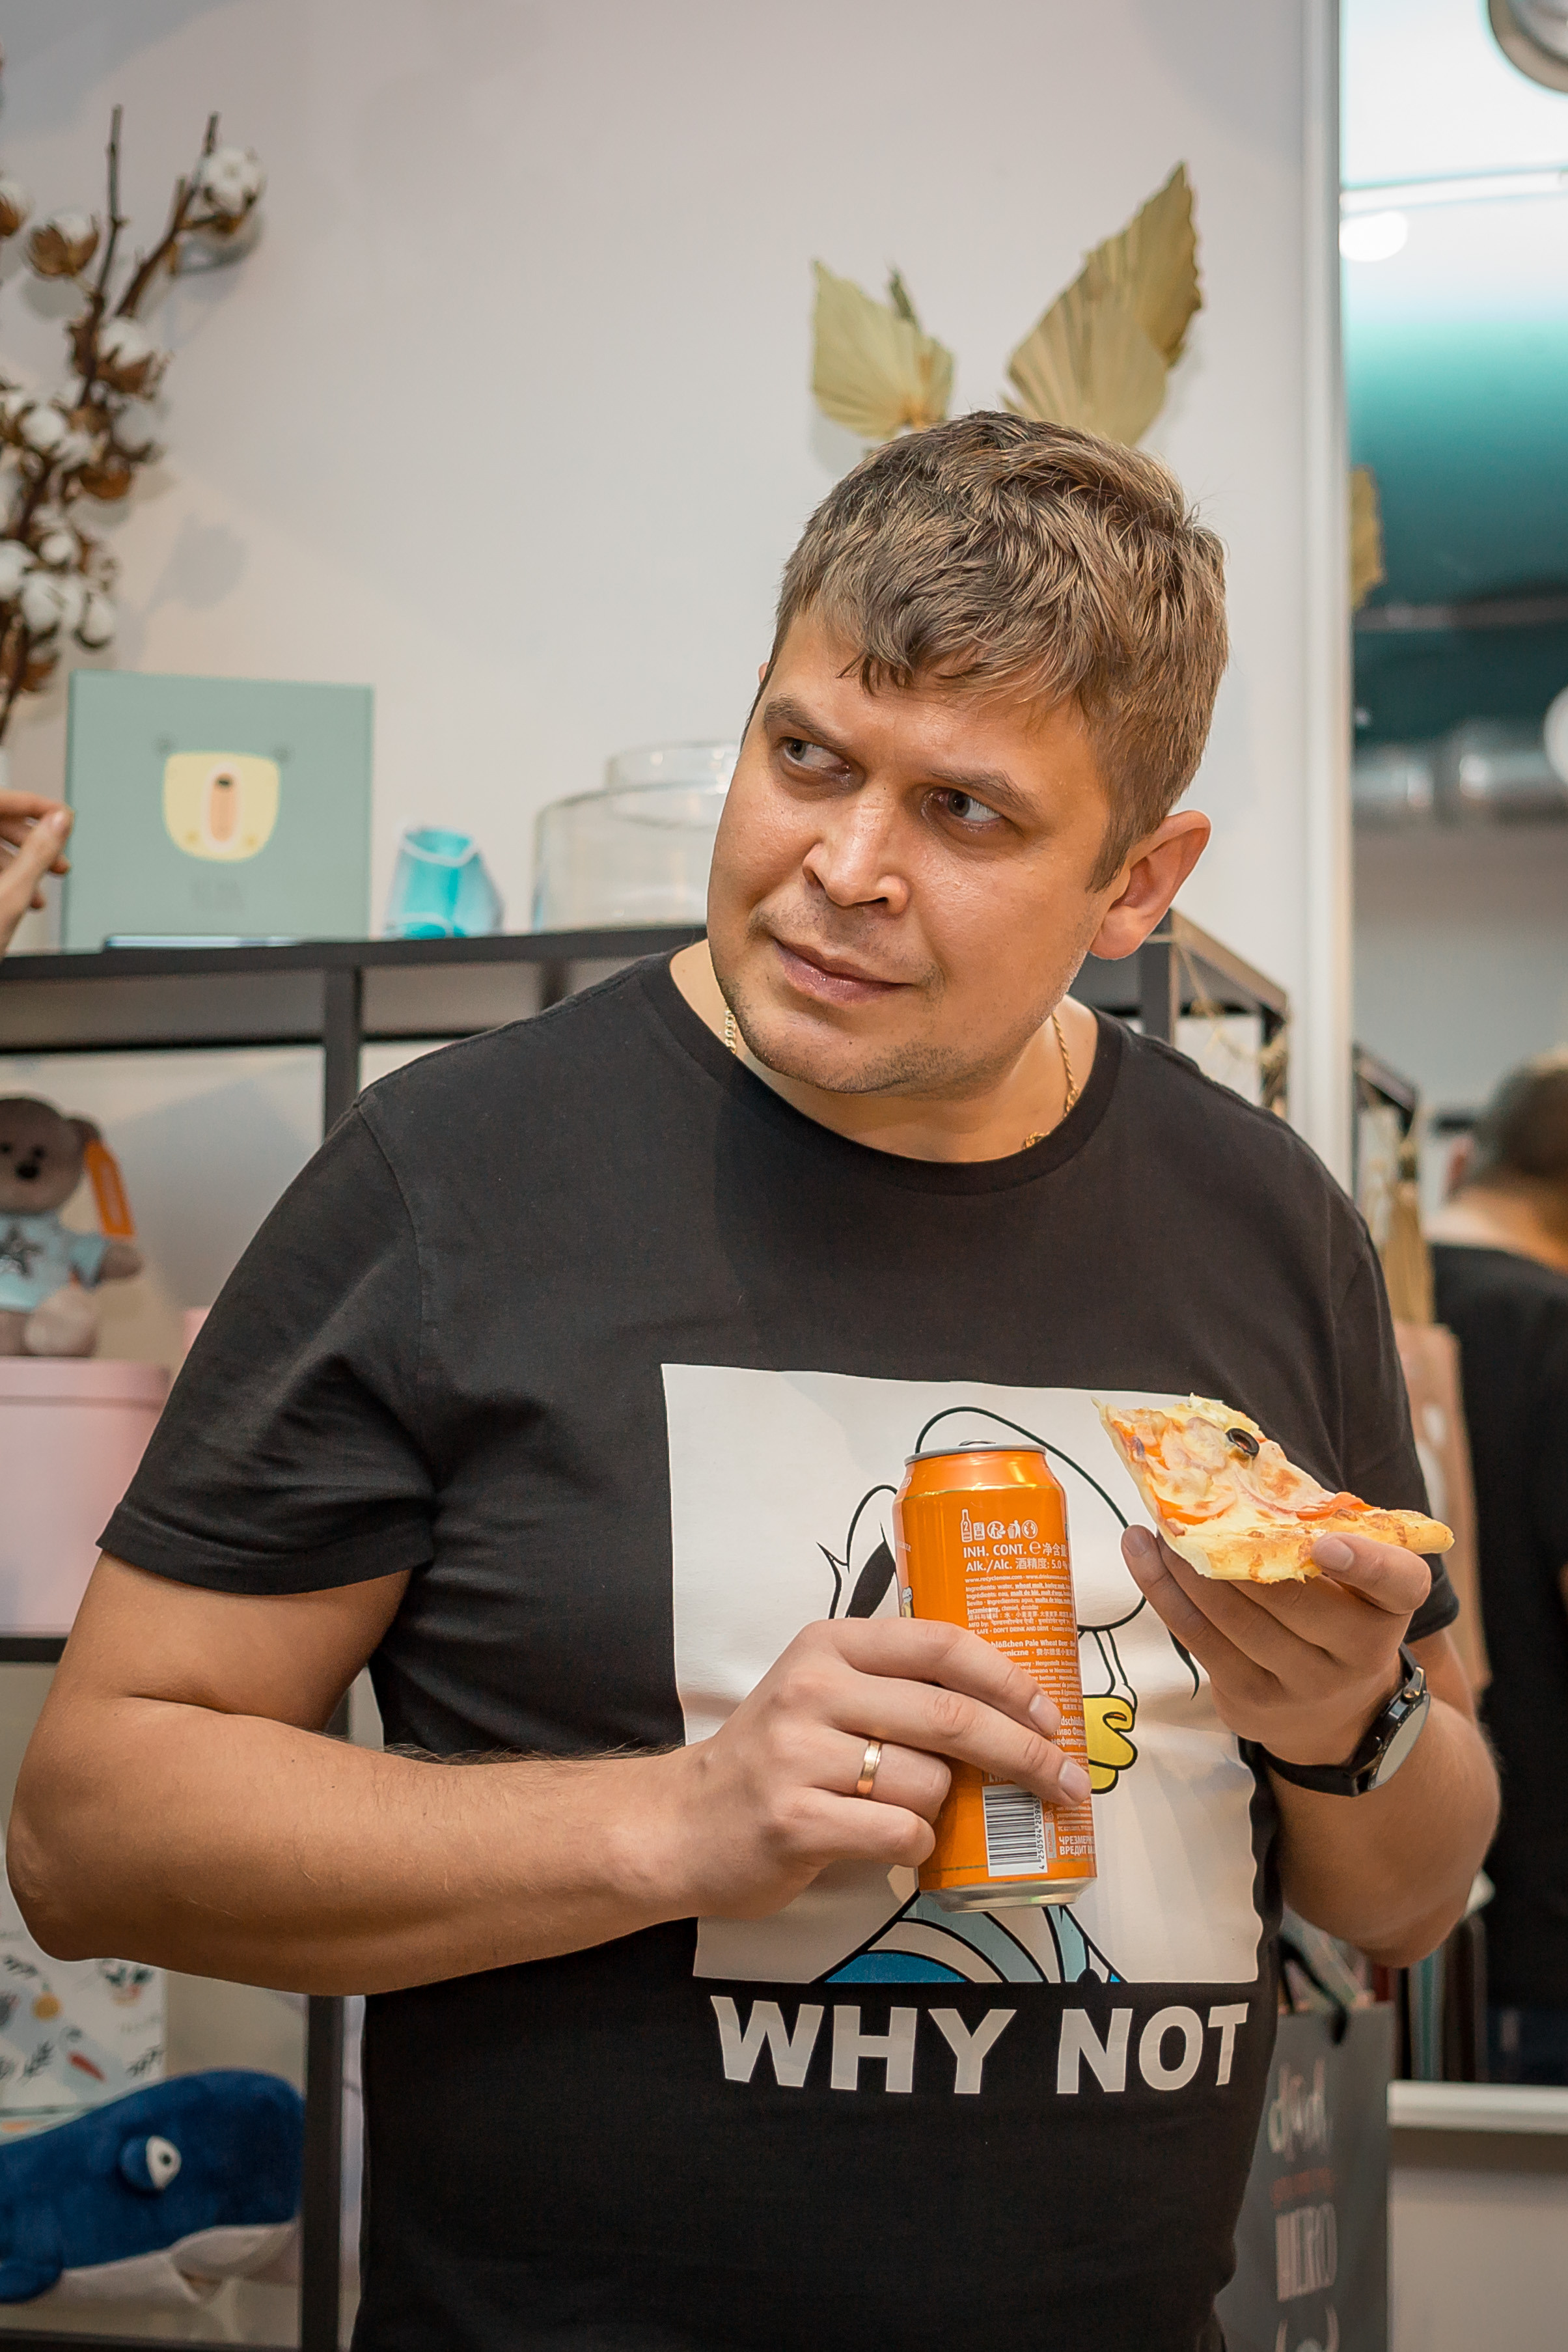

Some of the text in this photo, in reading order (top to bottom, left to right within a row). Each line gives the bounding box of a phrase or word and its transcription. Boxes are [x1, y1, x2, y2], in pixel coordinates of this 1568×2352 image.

[963, 1545, 989, 1558] INH.
[993, 1543, 1027, 1556] CONT.
[966, 1558, 1013, 1573] Alk./Alc.
[1060, 1845, 1086, 1856] ВРЕДИТ
[711, 1996, 1249, 2093] WHY NOT
